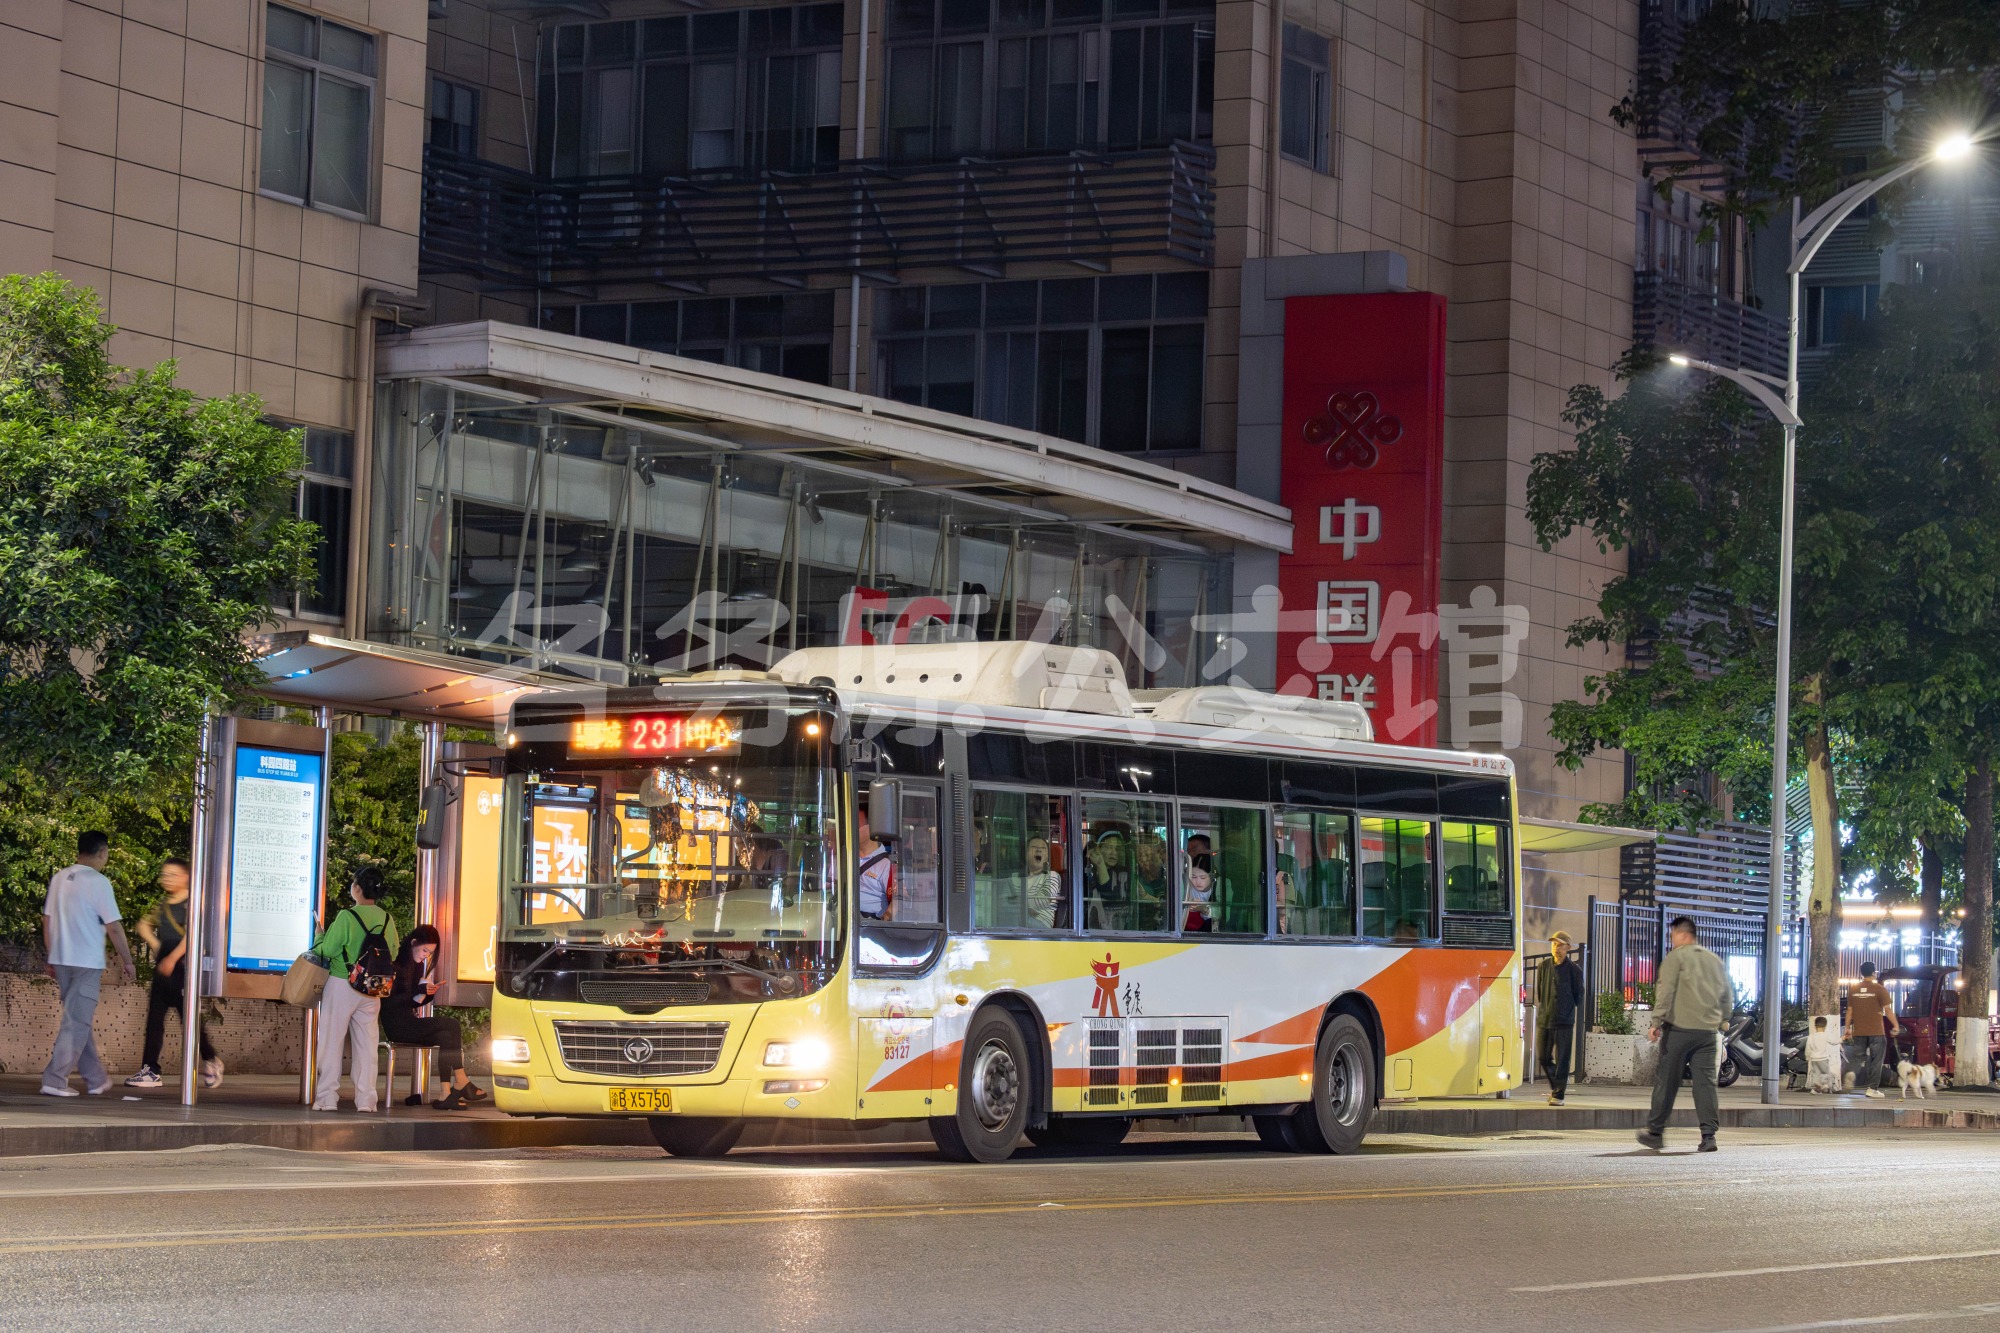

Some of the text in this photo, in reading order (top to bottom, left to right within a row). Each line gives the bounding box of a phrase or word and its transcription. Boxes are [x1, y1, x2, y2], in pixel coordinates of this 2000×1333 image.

[633, 720, 681, 748] 231
[1090, 1019, 1125, 1030] CHONG QING
[884, 1045, 910, 1060] 83127
